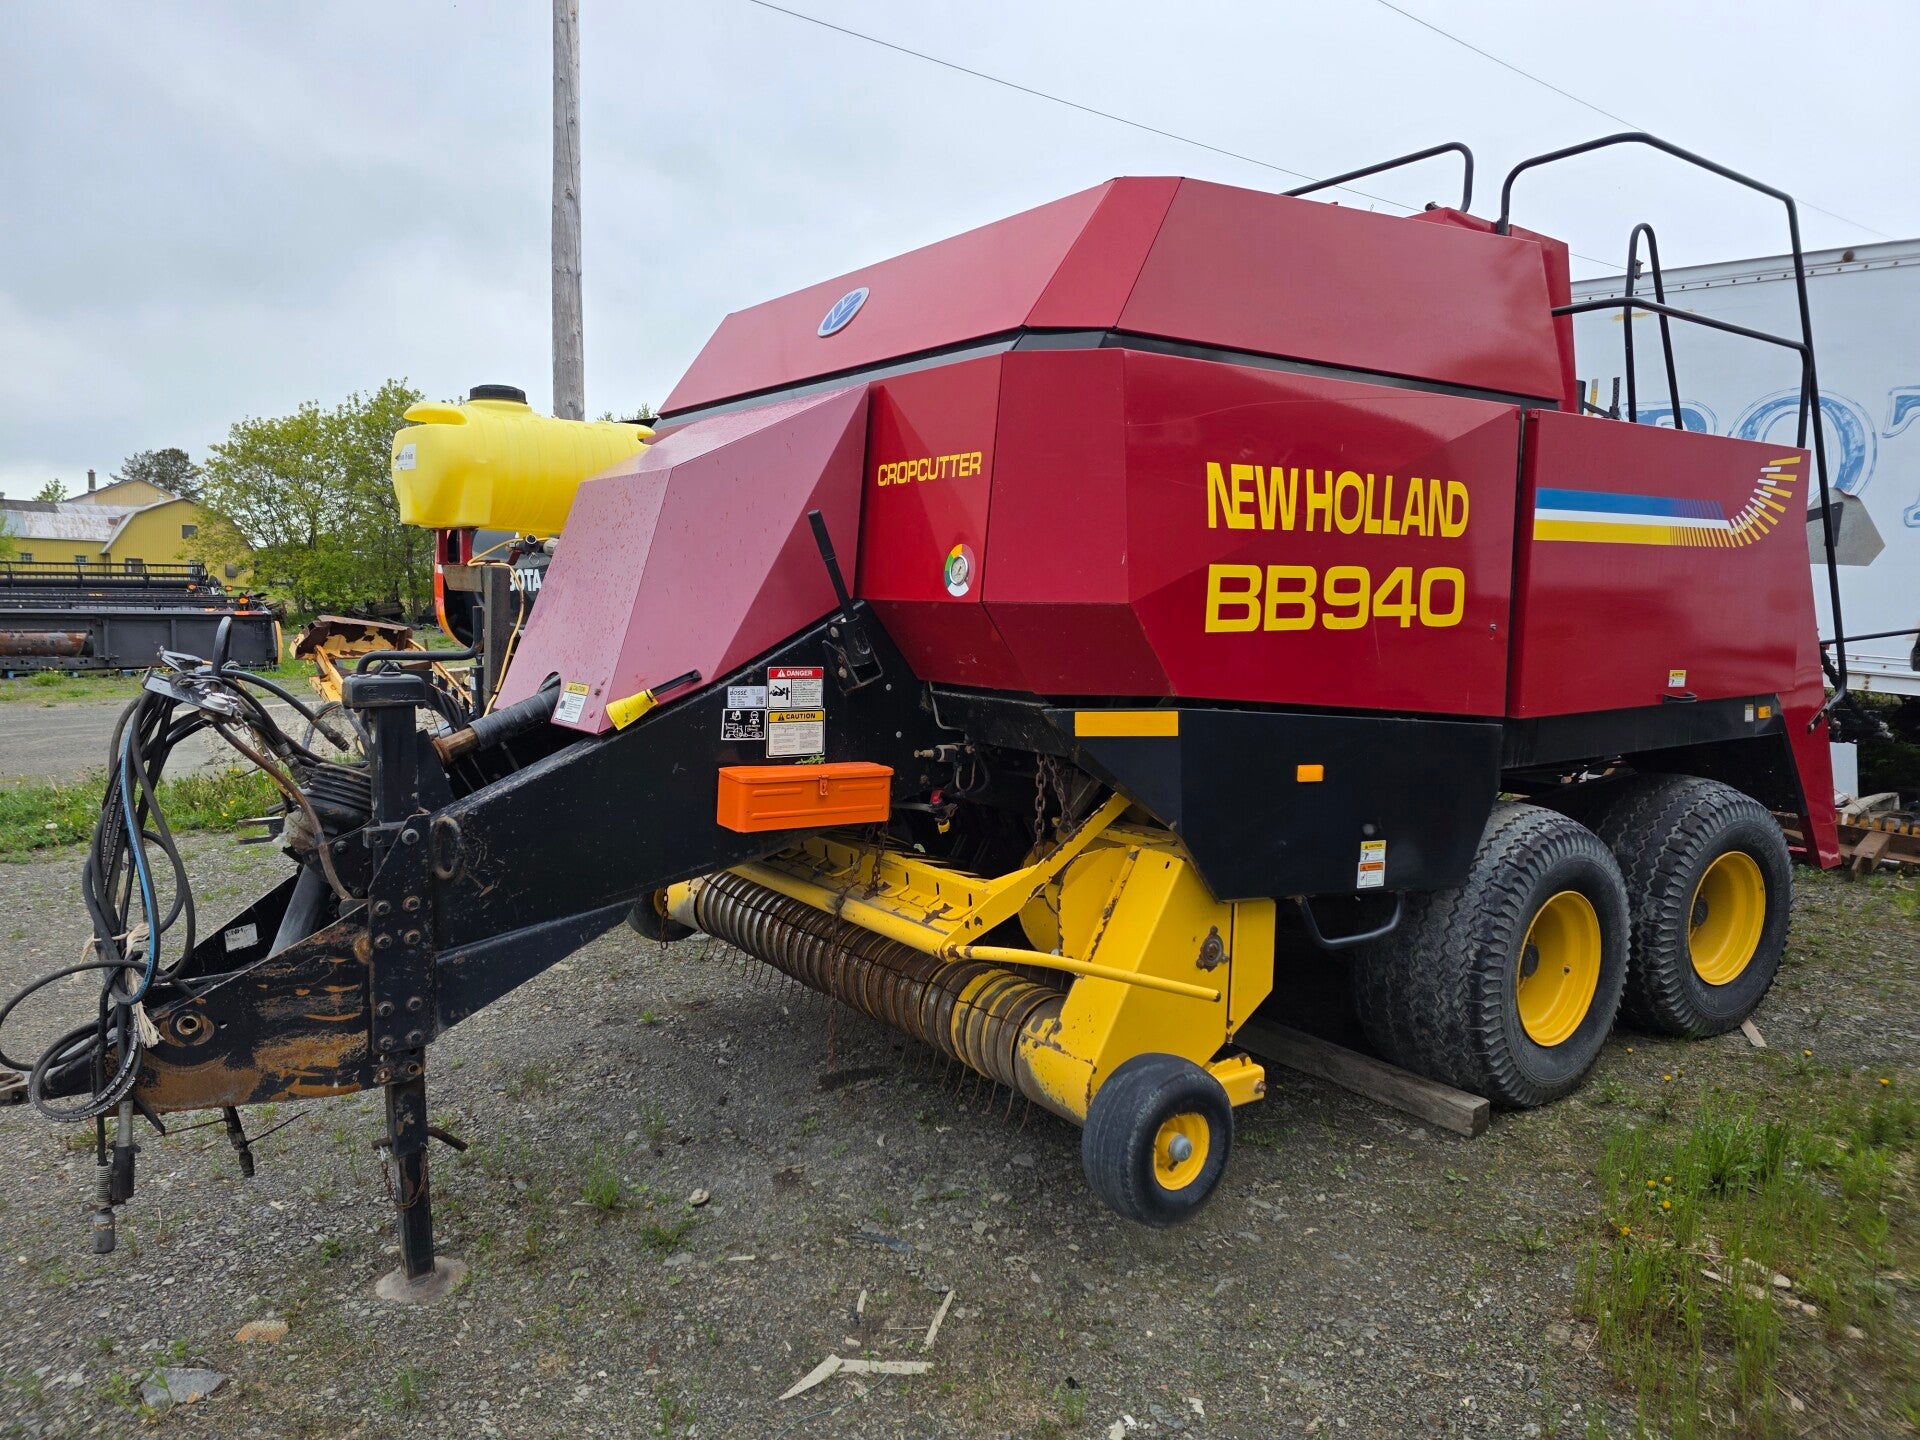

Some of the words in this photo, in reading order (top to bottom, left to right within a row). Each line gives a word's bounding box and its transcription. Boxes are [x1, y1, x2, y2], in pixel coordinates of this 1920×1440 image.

[877, 450, 983, 487] CROPCUTTER
[1206, 461, 1301, 531] NEW
[1305, 469, 1470, 538] HOLLAND
[1204, 562, 1466, 634] BB940
[785, 712, 816, 720] CAUTION
